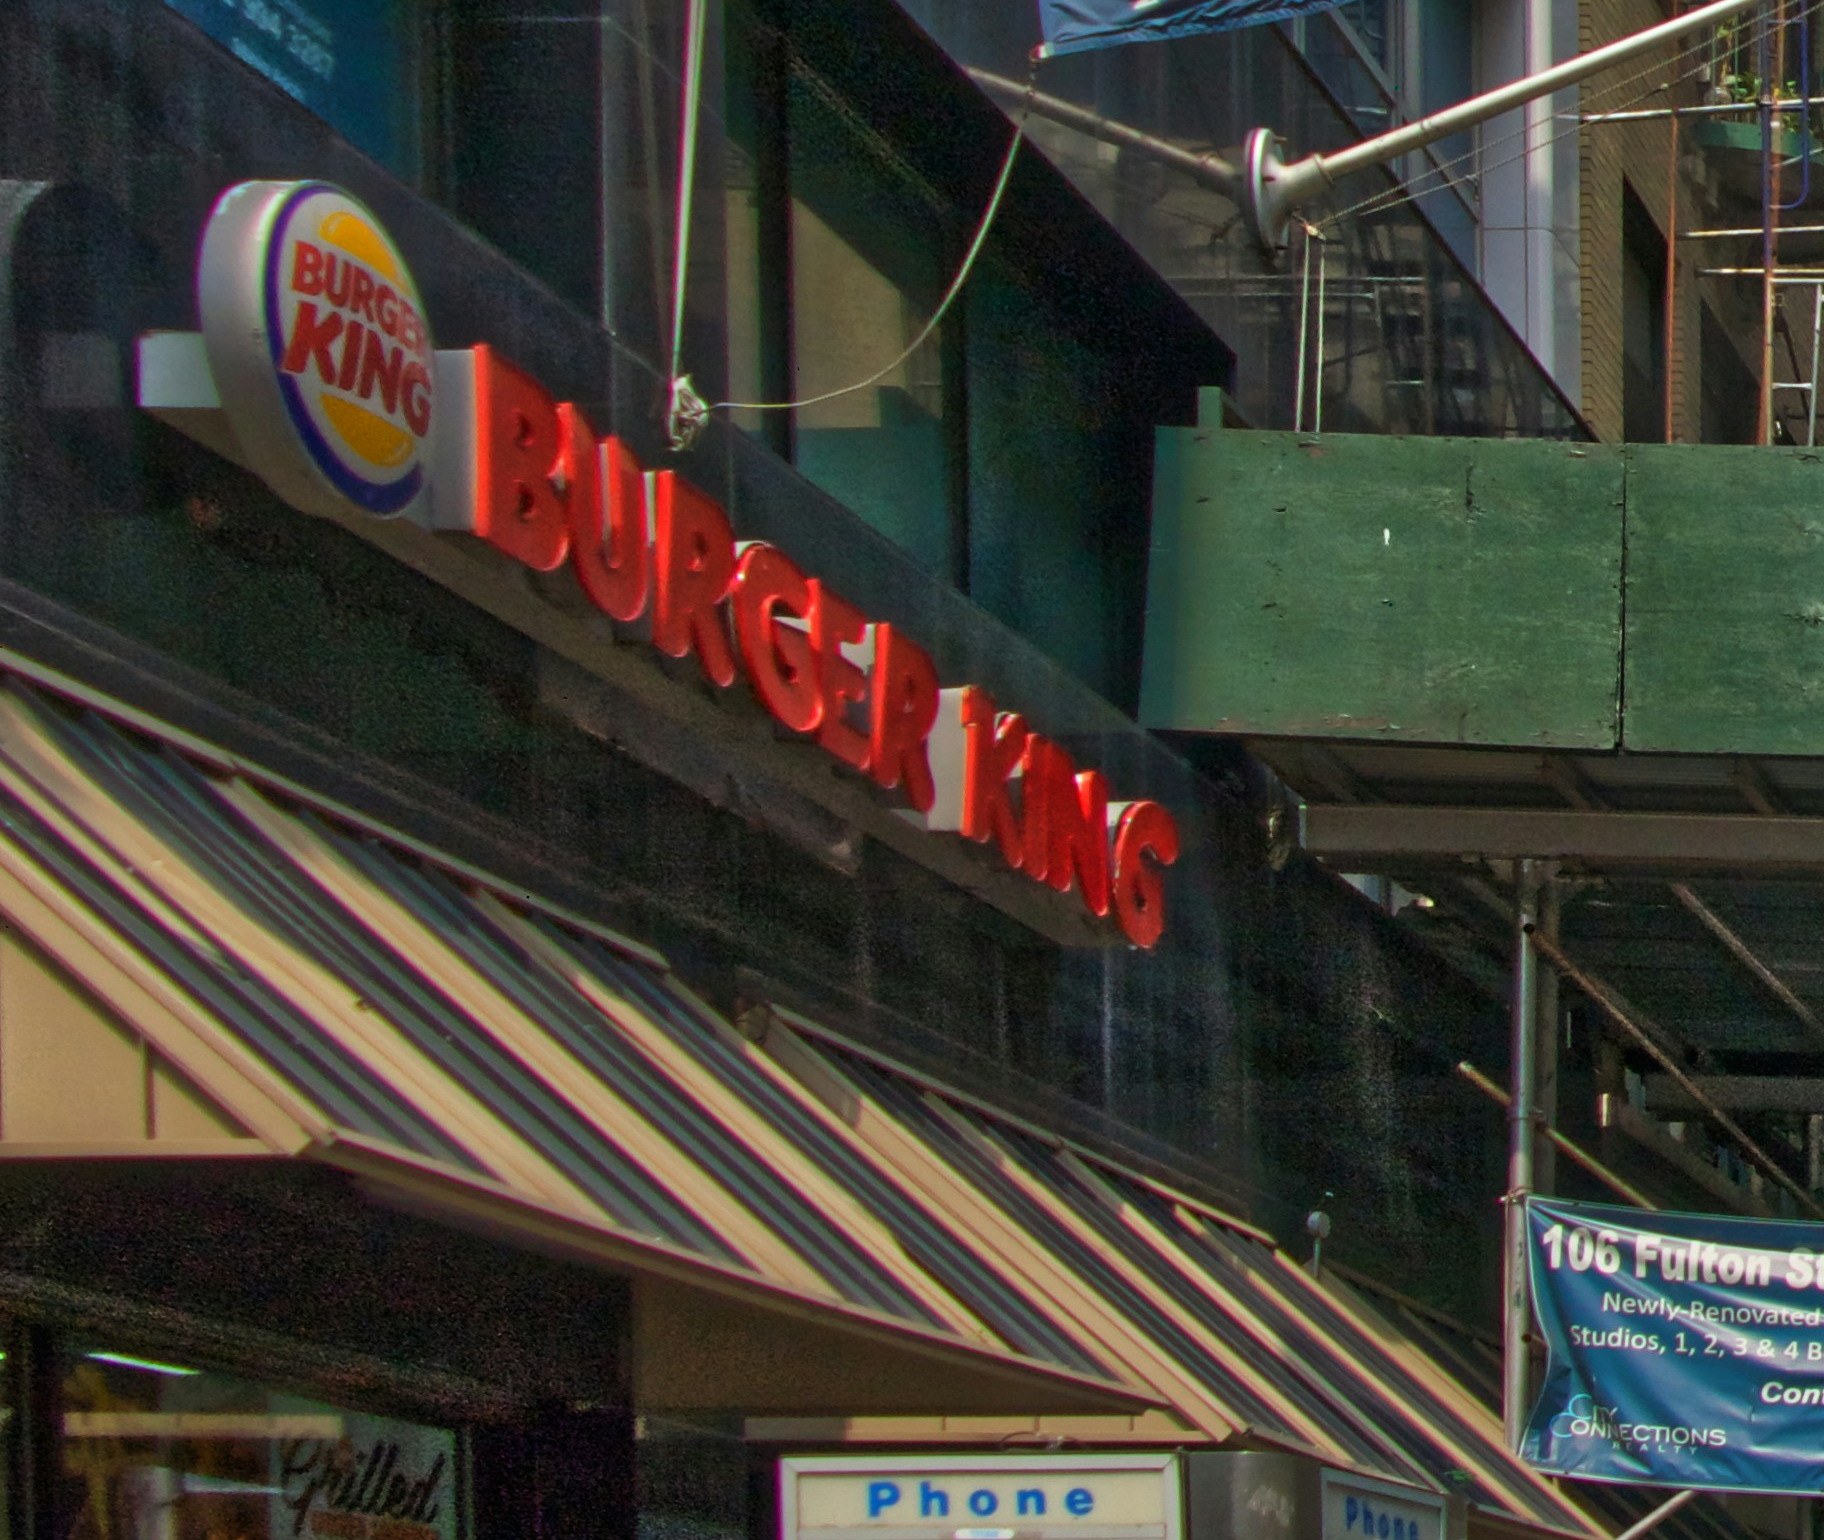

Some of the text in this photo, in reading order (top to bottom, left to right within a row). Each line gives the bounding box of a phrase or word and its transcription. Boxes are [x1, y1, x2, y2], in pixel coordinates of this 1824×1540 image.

[281, 299, 433, 438] KING
[472, 342, 1180, 950] BURGER KING
[1541, 1222, 1622, 1274] 106
[1634, 1233, 1773, 1288] Fulton
[1602, 1291, 1820, 1328] Newly-Renovated
[1569, 1324, 1667, 1355] Studios,
[1673, 1332, 1696, 1356] 1,
[1703, 1333, 1726, 1358] 2,
[1732, 1337, 1749, 1356] 3
[1755, 1338, 1776, 1358] &
[1783, 1340, 1800, 1360] 4
[1549, 1411, 1727, 1447] CONNECTIONS
[1611, 1441, 1698, 1456] REALTY
[867, 1481, 1096, 1517] Phone
[1345, 1495, 1419, 1540] Phone
